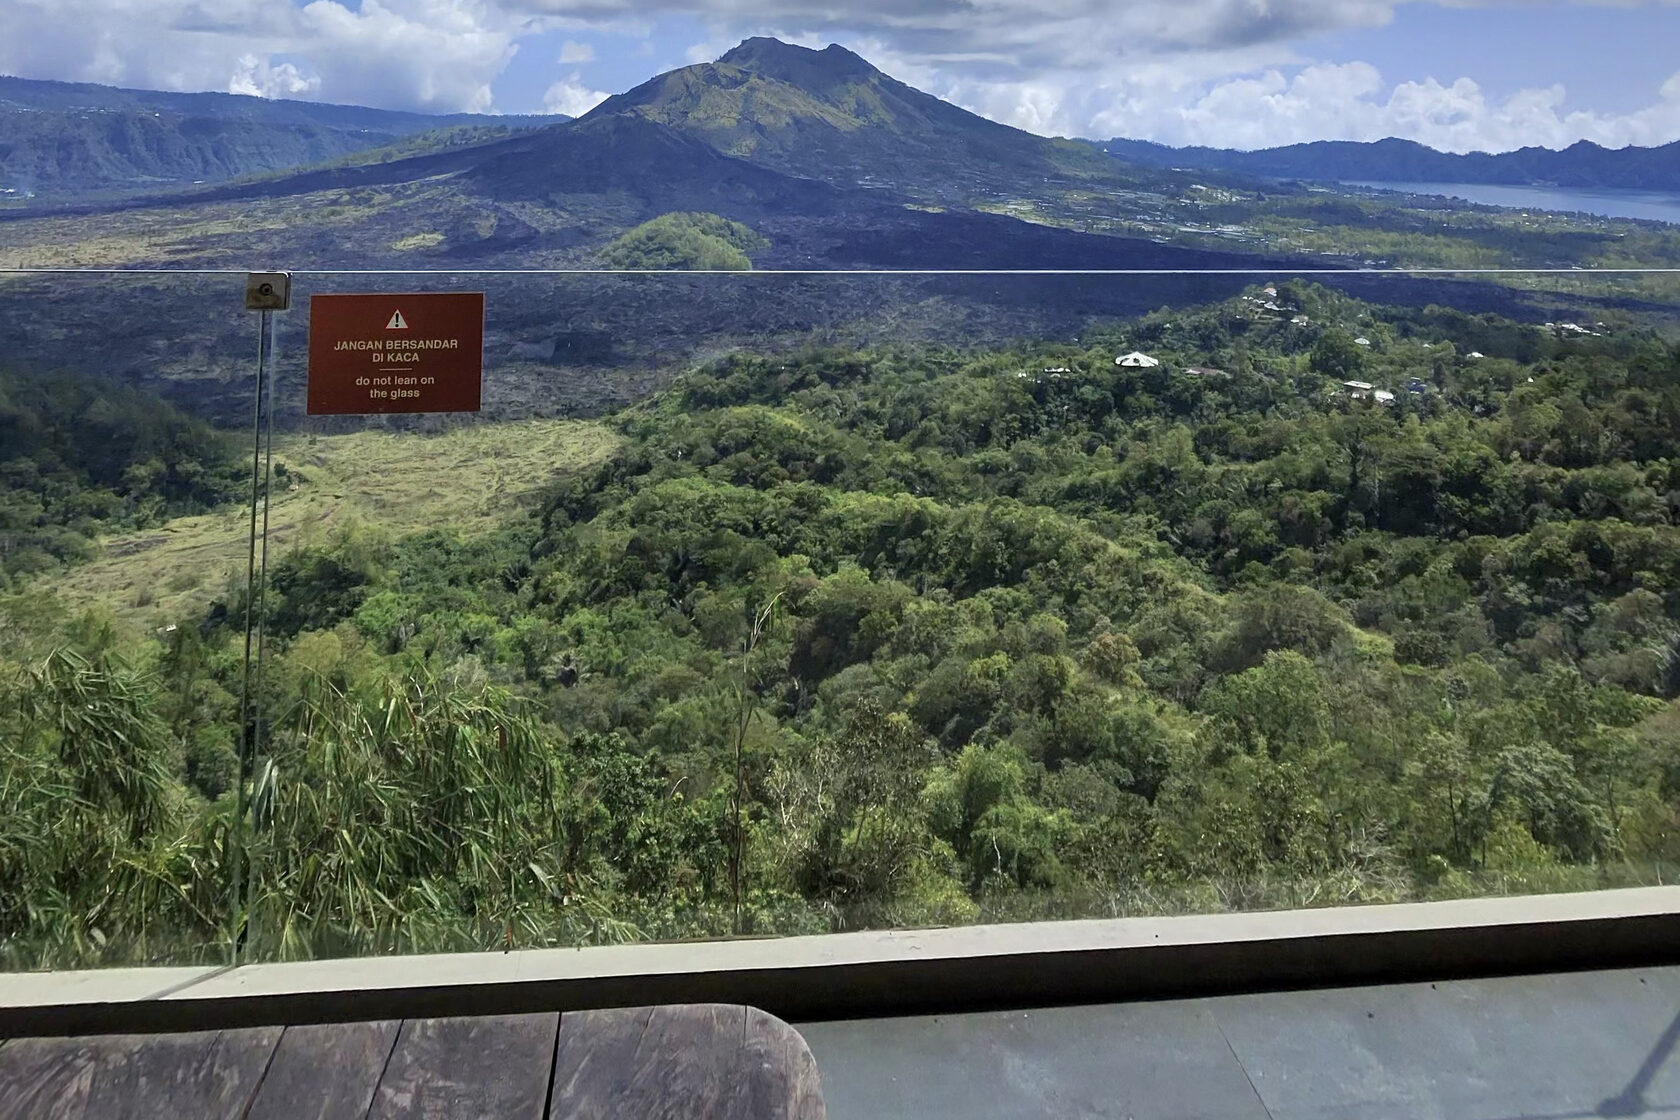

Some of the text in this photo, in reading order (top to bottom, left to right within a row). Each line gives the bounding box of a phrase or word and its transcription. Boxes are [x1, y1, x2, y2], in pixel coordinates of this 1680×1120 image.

[333, 339, 458, 351] JANGAN BERSANDAR
[372, 352, 420, 363] DI KACA
[355, 376, 435, 386] do not lean on
[369, 388, 420, 400] the glass
